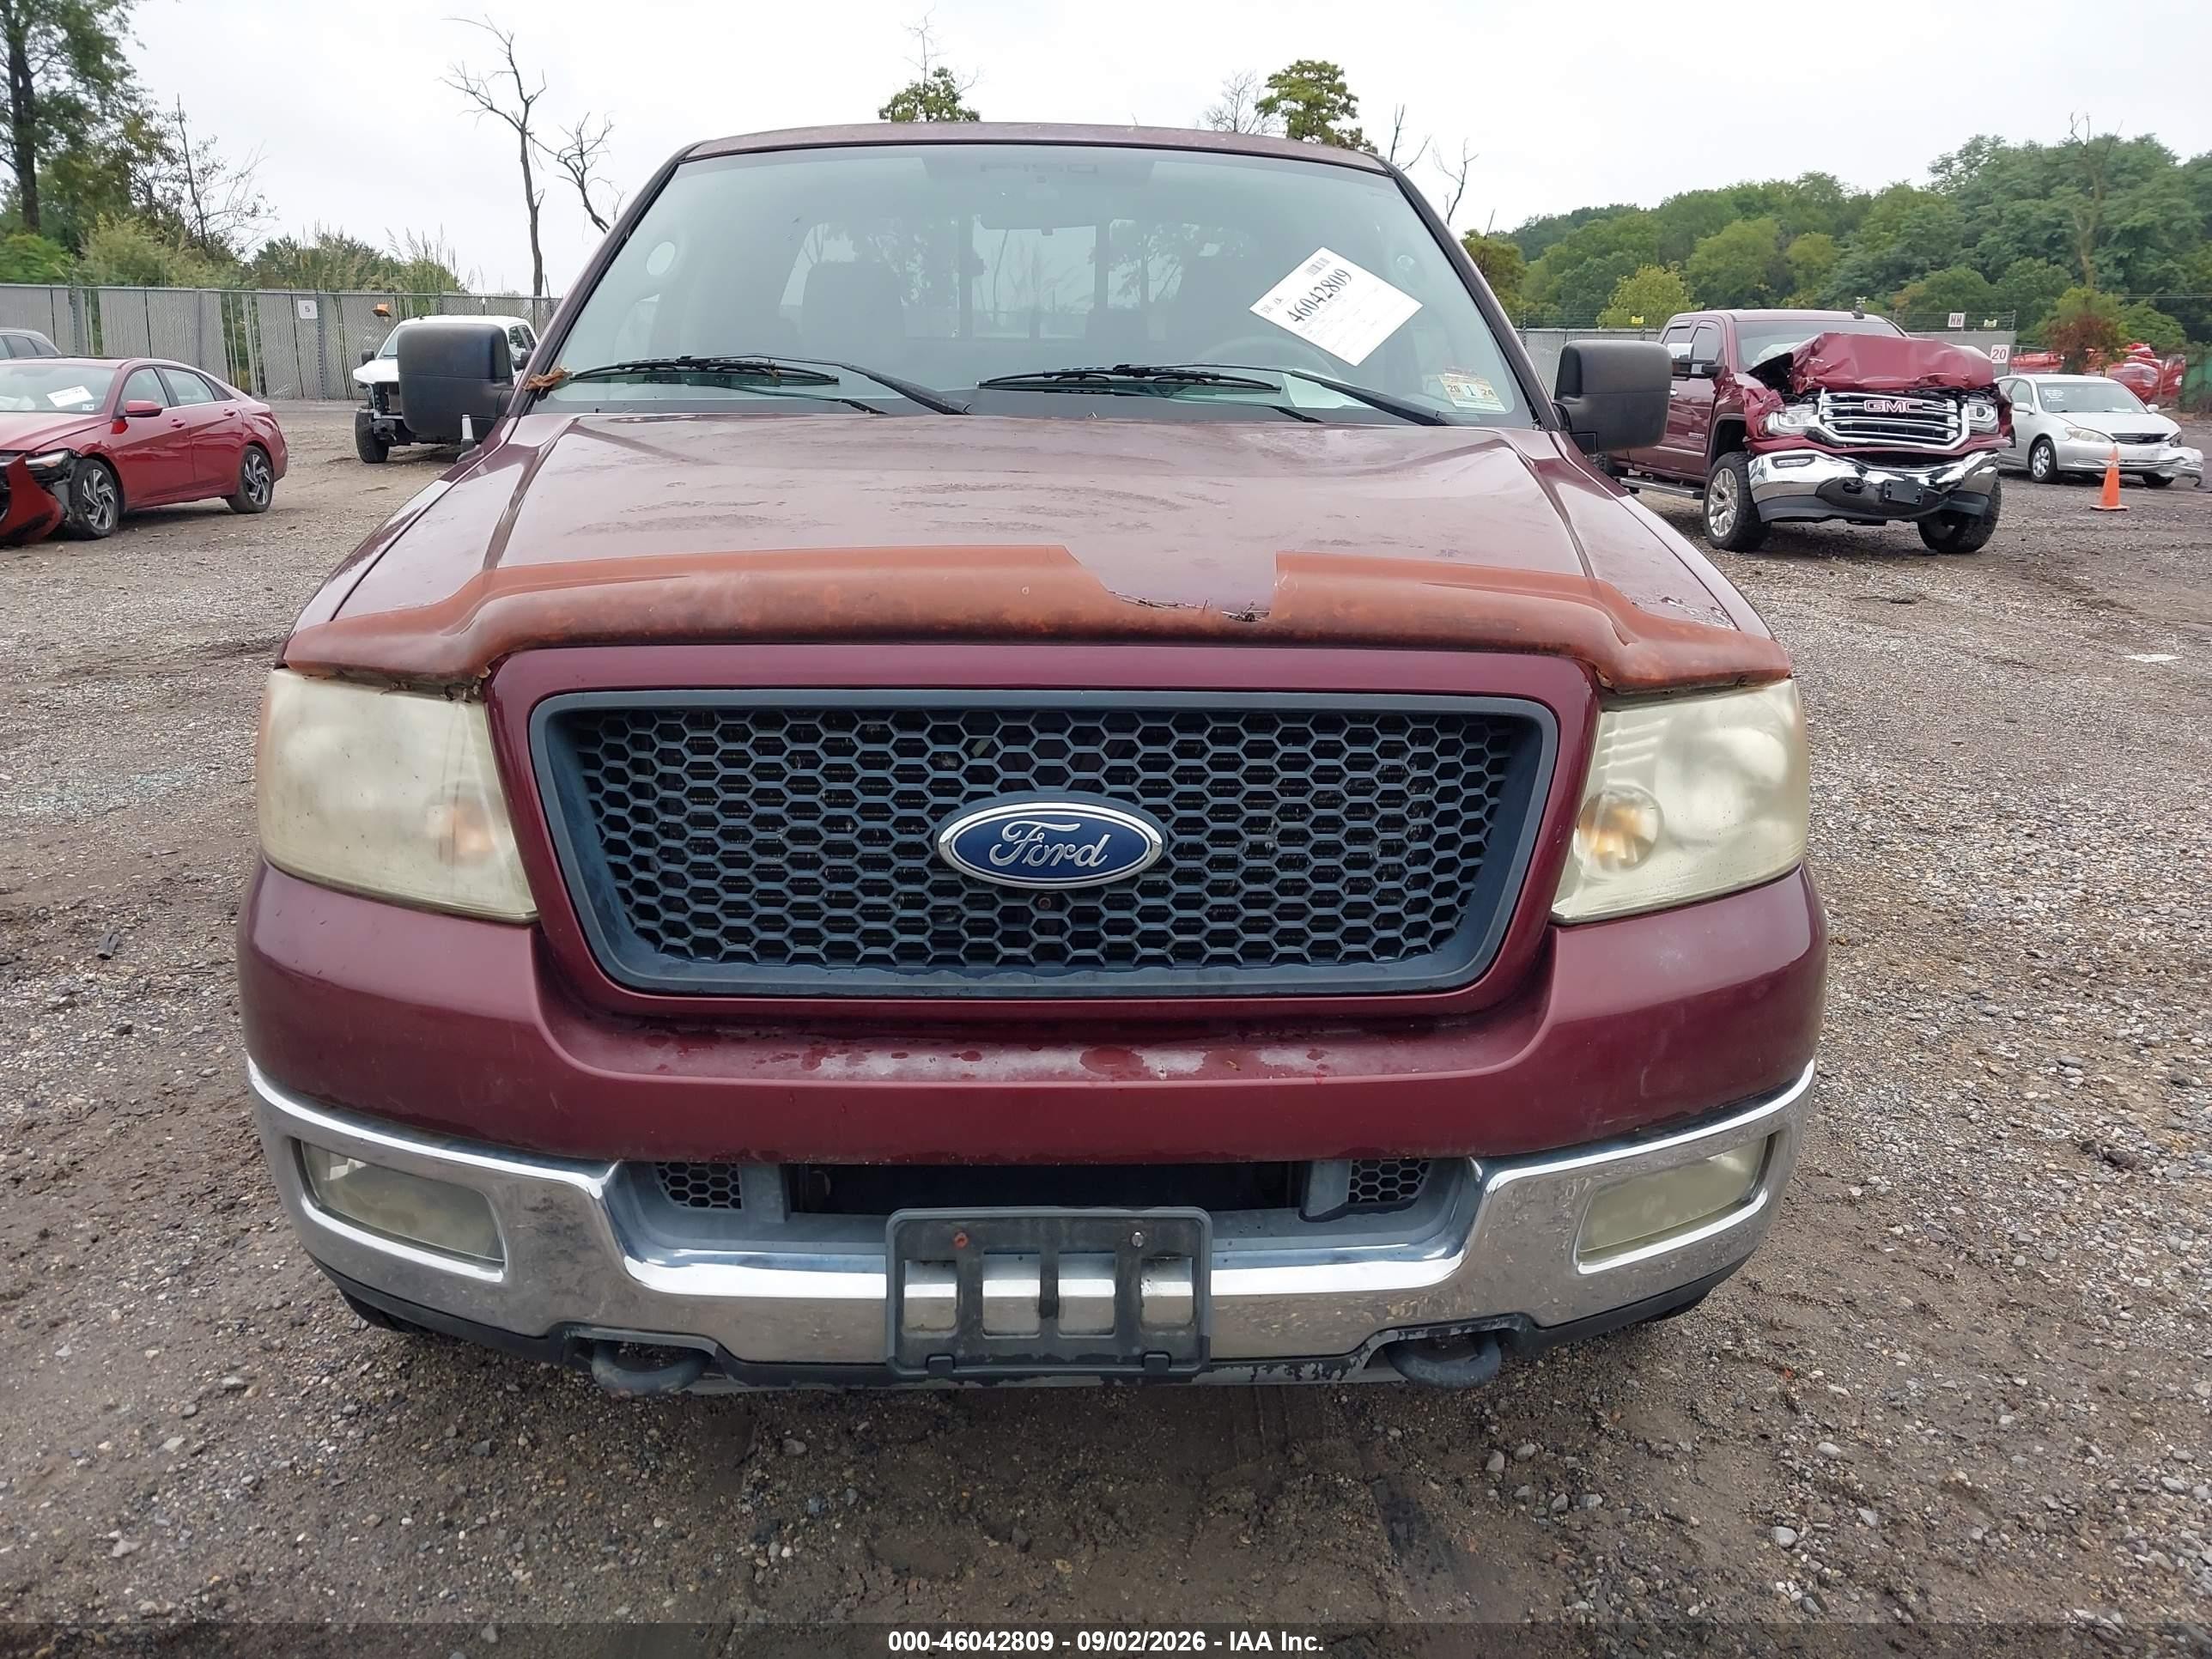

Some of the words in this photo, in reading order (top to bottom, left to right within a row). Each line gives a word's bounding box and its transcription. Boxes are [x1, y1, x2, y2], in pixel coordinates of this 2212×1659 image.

[1287, 268, 1352, 322] 46042809
[1991, 349, 2007, 360] 20
[1863, 399, 1923, 413] GMC
[988, 820, 1111, 867] Ford
